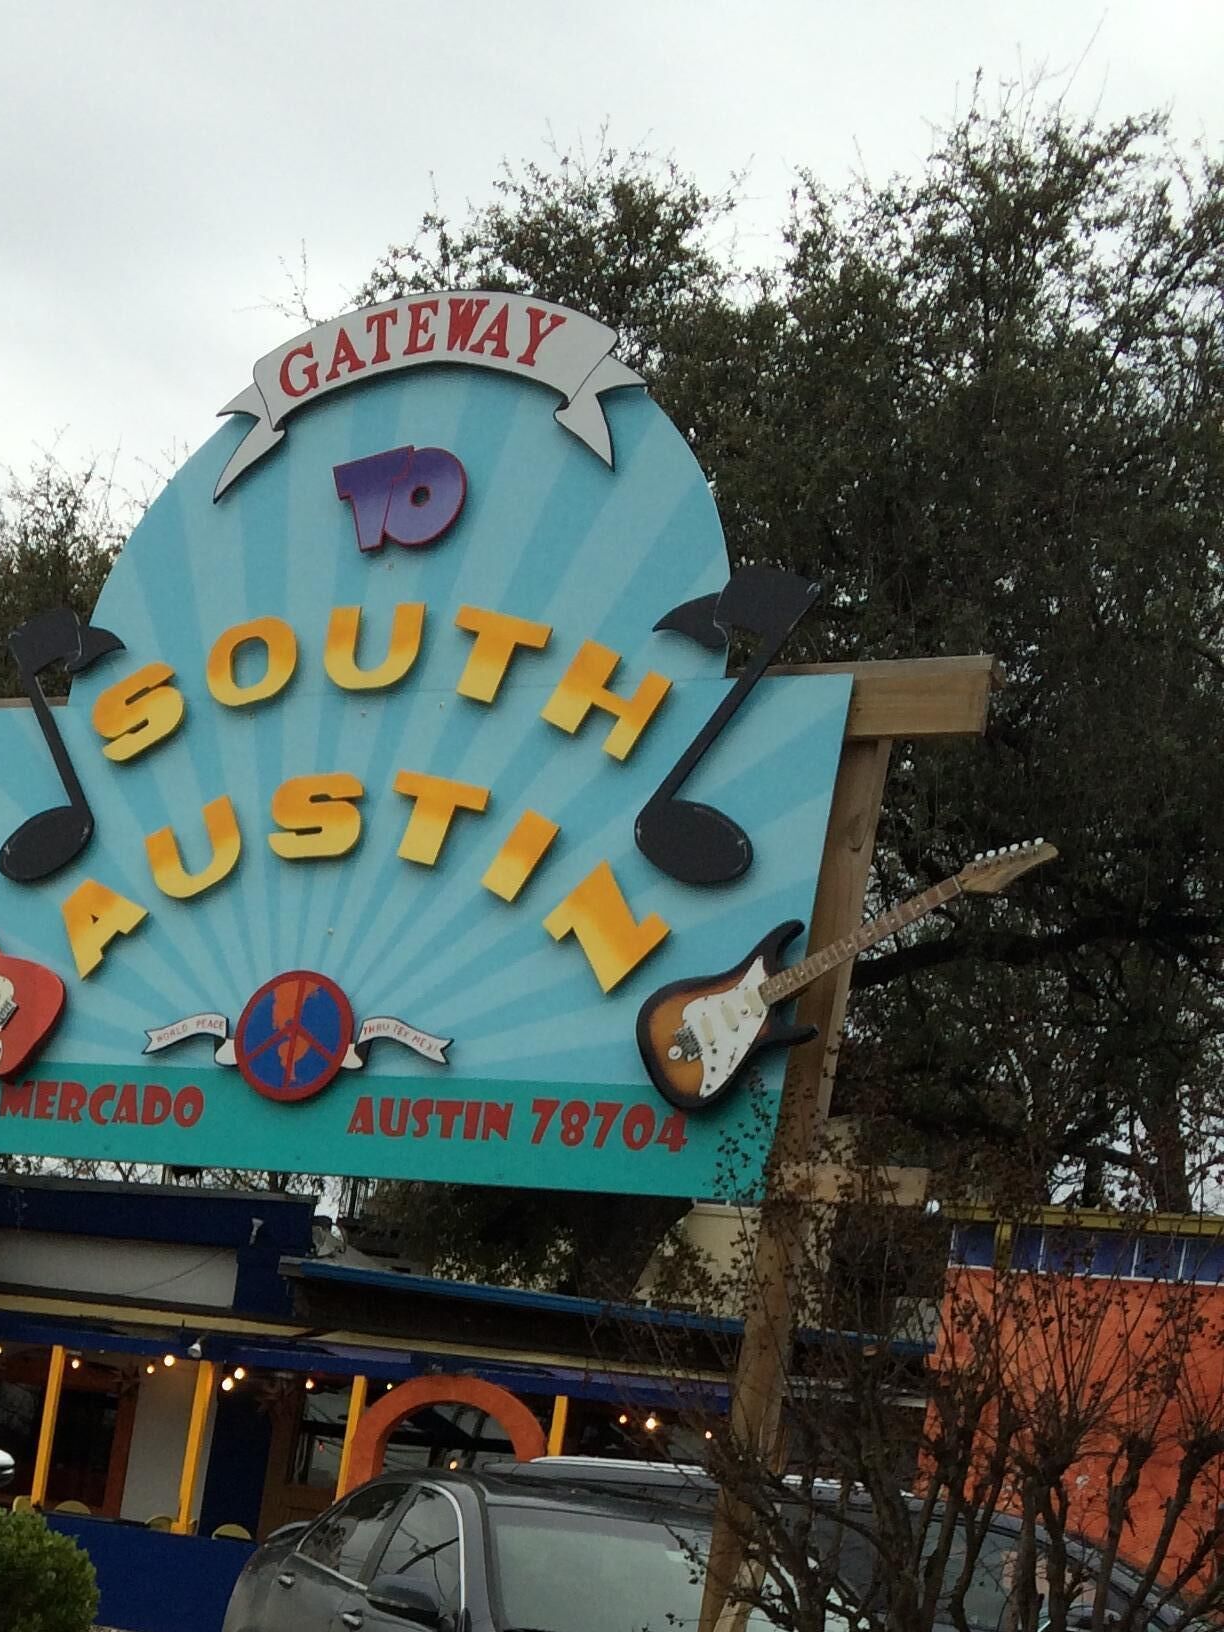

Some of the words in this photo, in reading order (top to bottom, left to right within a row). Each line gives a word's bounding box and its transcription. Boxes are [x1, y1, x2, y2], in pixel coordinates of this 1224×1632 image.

[277, 296, 568, 400] GATEWAY
[331, 443, 468, 553] TO
[91, 601, 674, 763] SOUTH
[58, 769, 672, 994] AUSTIN
[157, 1023, 188, 1042] WORLD
[196, 1018, 225, 1030] PEACE
[347, 1096, 514, 1141] AUSTIN
[531, 1098, 688, 1153] 78704
